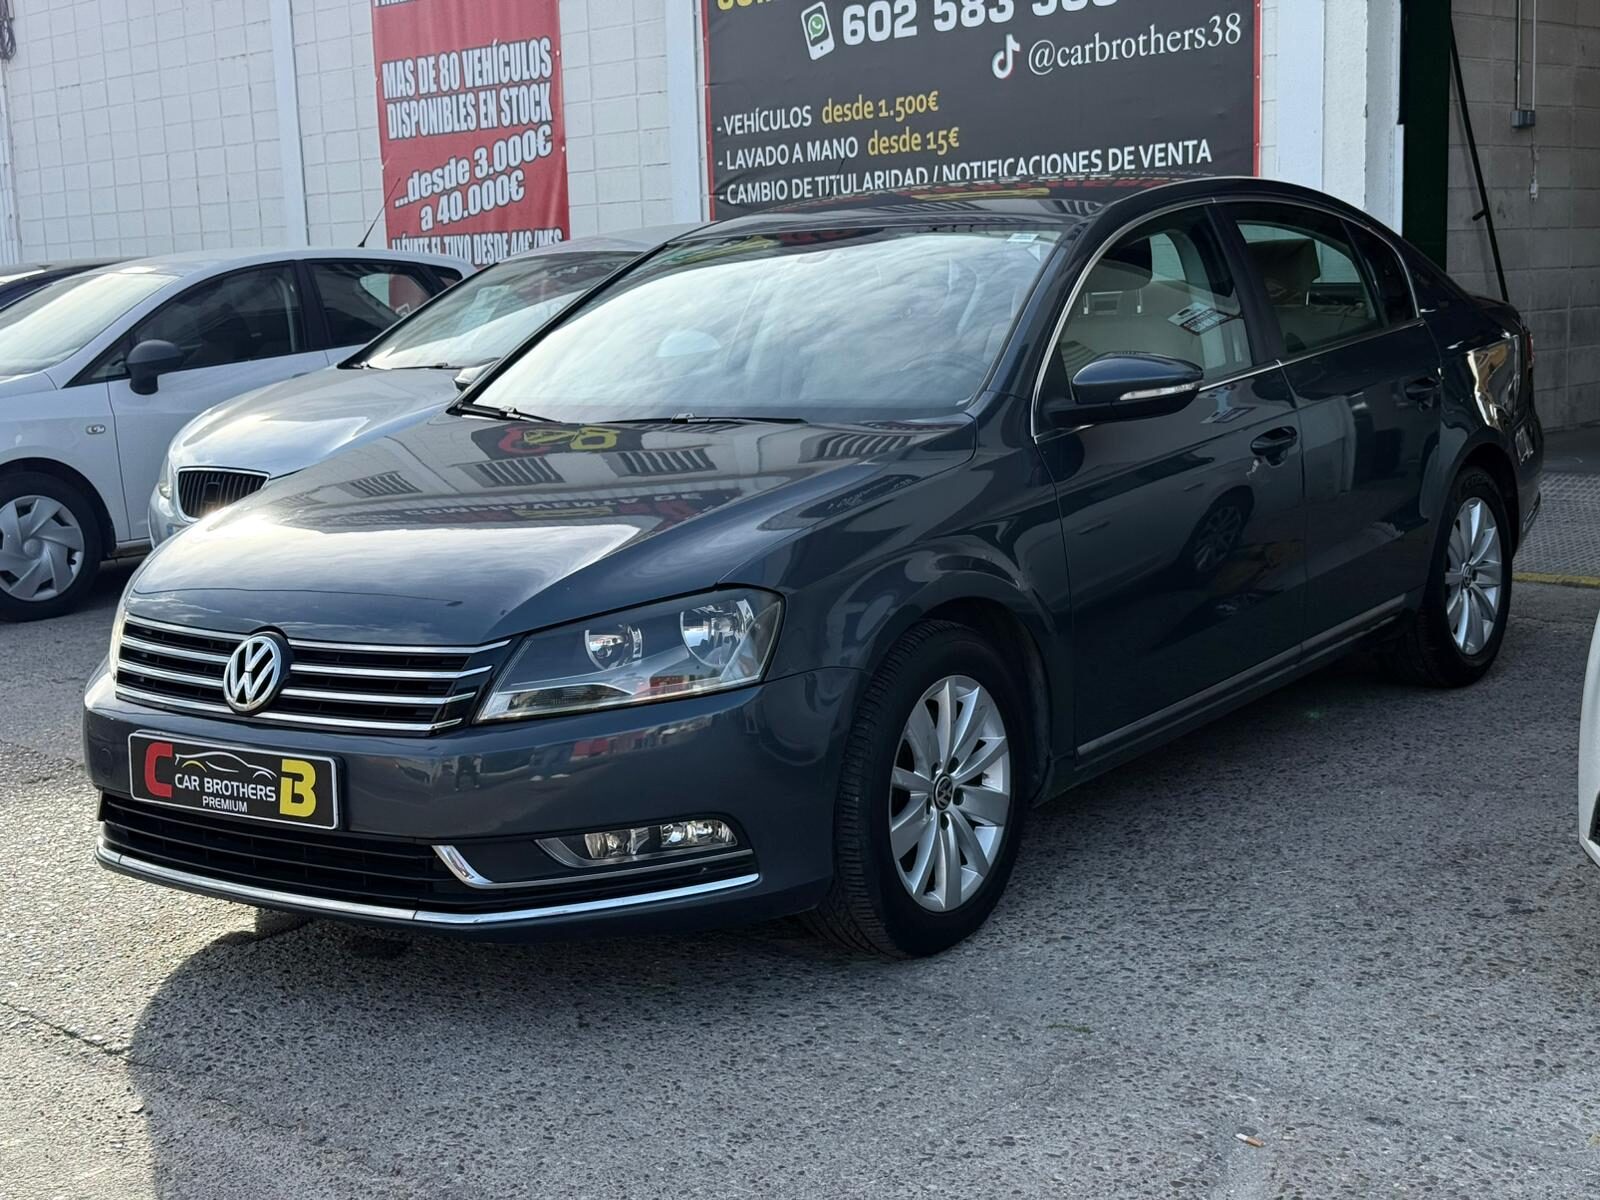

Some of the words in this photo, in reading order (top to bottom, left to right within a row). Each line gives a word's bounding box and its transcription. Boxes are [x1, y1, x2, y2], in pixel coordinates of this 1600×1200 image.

[842, 0, 918, 46] 602
[1028, 12, 1242, 76] @carbrothers38
[382, 60, 416, 100] MAS
[417, 55, 437, 95] DE
[438, 51, 461, 92] 80
[461, 37, 552, 89] VEHÍCULOS
[387, 92, 477, 140] DISPONIBLES
[478, 89, 498, 130] EN
[499, 82, 553, 127] STOCK
[821, 94, 874, 125] desde
[878, 90, 940, 122] 1.500€
[474, 124, 553, 180] 3.000€
[791, 142, 804, 165] A
[806, 136, 859, 162] MANO
[867, 126, 922, 157] desde
[926, 126, 960, 156] 15€
[791, 176, 813, 200] DE
[814, 166, 929, 198] TITULARIDAD
[942, 149, 1103, 182] NOTIFICACIONES
[1108, 145, 1136, 173] DE
[1138, 138, 1213, 168] VENTA
[420, 204, 434, 232] a
[436, 169, 525, 226] 40.000€
[473, 231, 508, 265] DESDE
[174, 773, 200, 792] CAR
[203, 777, 277, 802] BROTHERS
[202, 795, 248, 813] PREMIUM
